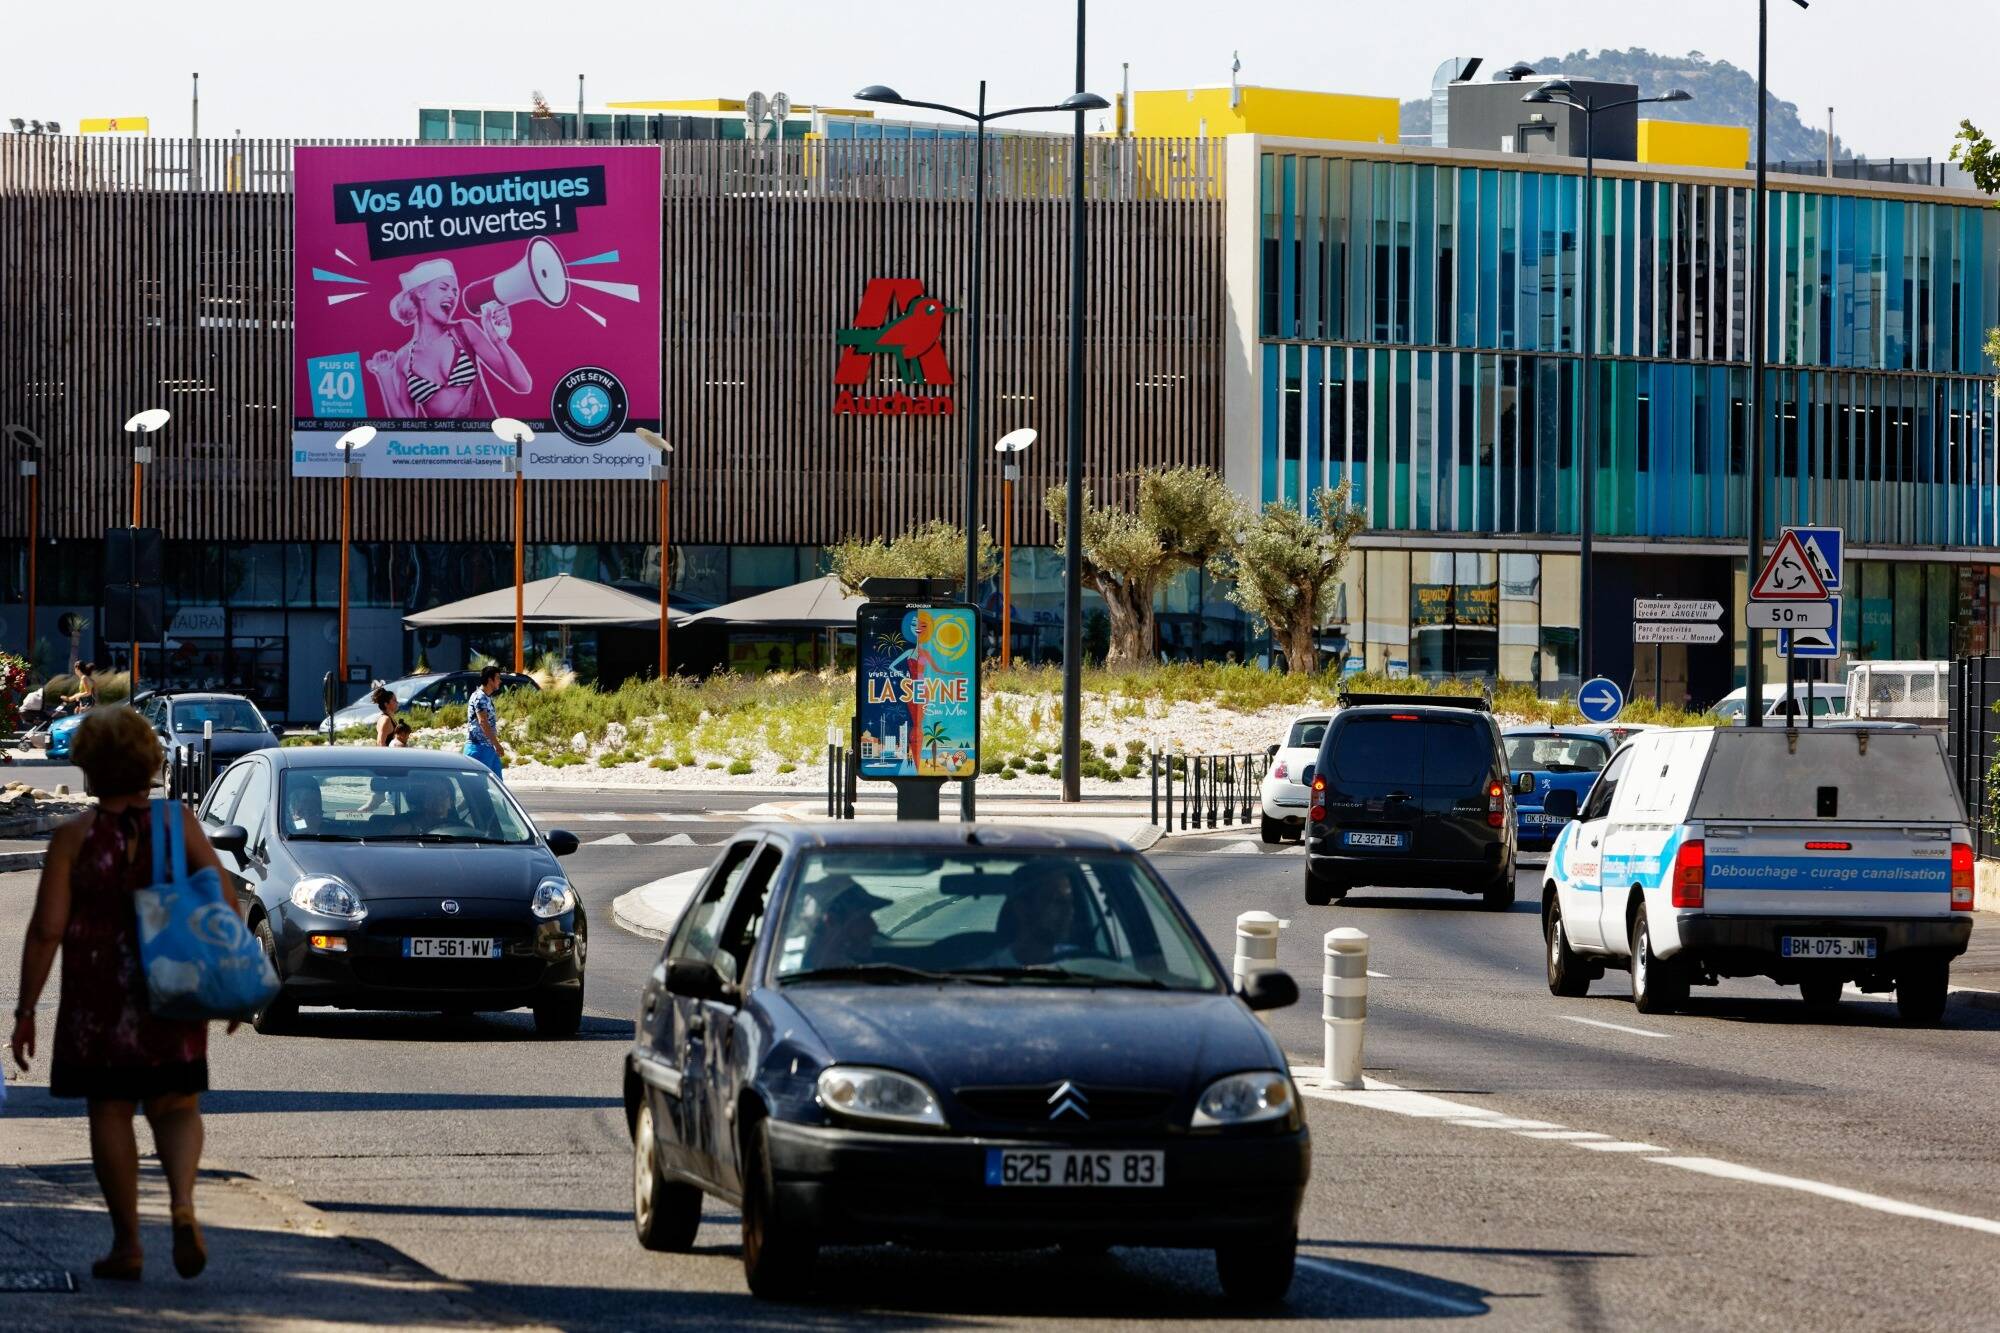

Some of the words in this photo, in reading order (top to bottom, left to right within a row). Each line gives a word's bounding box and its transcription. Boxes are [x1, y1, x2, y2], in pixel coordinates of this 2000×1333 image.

[350, 188, 400, 214] Vos
[408, 183, 442, 209] 40
[451, 176, 590, 207] boutiques
[381, 214, 434, 242] sont
[440, 207, 547, 236] ouvertes
[555, 203, 561, 228] !
[319, 361, 343, 370] PLUS
[345, 361, 355, 370] DE
[318, 371, 355, 400] 40
[566, 371, 587, 389] CÔTÉ
[587, 371, 615, 390] SEYNE
[833, 389, 954, 415] Auchan
[323, 421, 345, 430] BIJOUX
[386, 440, 449, 456] Auchan
[456, 443, 472, 456] LA
[475, 443, 516, 456] SEYNE
[392, 457, 502, 466] www.centrecommercial-laseyne.
[529, 453, 589, 464] Destination
[592, 453, 645, 468] Shopping
[1638, 602, 1671, 610] Complexe
[1673, 602, 1698, 610] Sportif
[1699, 602, 1717, 610] LERY
[1671, 610, 1708, 618] LANGEVIN
[175, 614, 248, 629] TAURANT
[1771, 608, 1794, 622] 50
[1797, 613, 1808, 622] m
[1656, 625, 1692, 633] d'activités
[1681, 633, 1688, 641] J.
[1690, 633, 1716, 641] Monnet
[867, 678, 897, 704] LA
[899, 677, 969, 704] SEYNE
[1710, 863, 1798, 880] Débouchage
[1810, 866, 1859, 881] curage
[1862, 867, 1946, 881] canalisation
[413, 938, 490, 957] CT-561-WV
[1792, 939, 1866, 956] BM-075-JN
[1003, 1154, 1050, 1184] 625
[1063, 1154, 1111, 1184] AAS
[1123, 1154, 1155, 1184] 83
